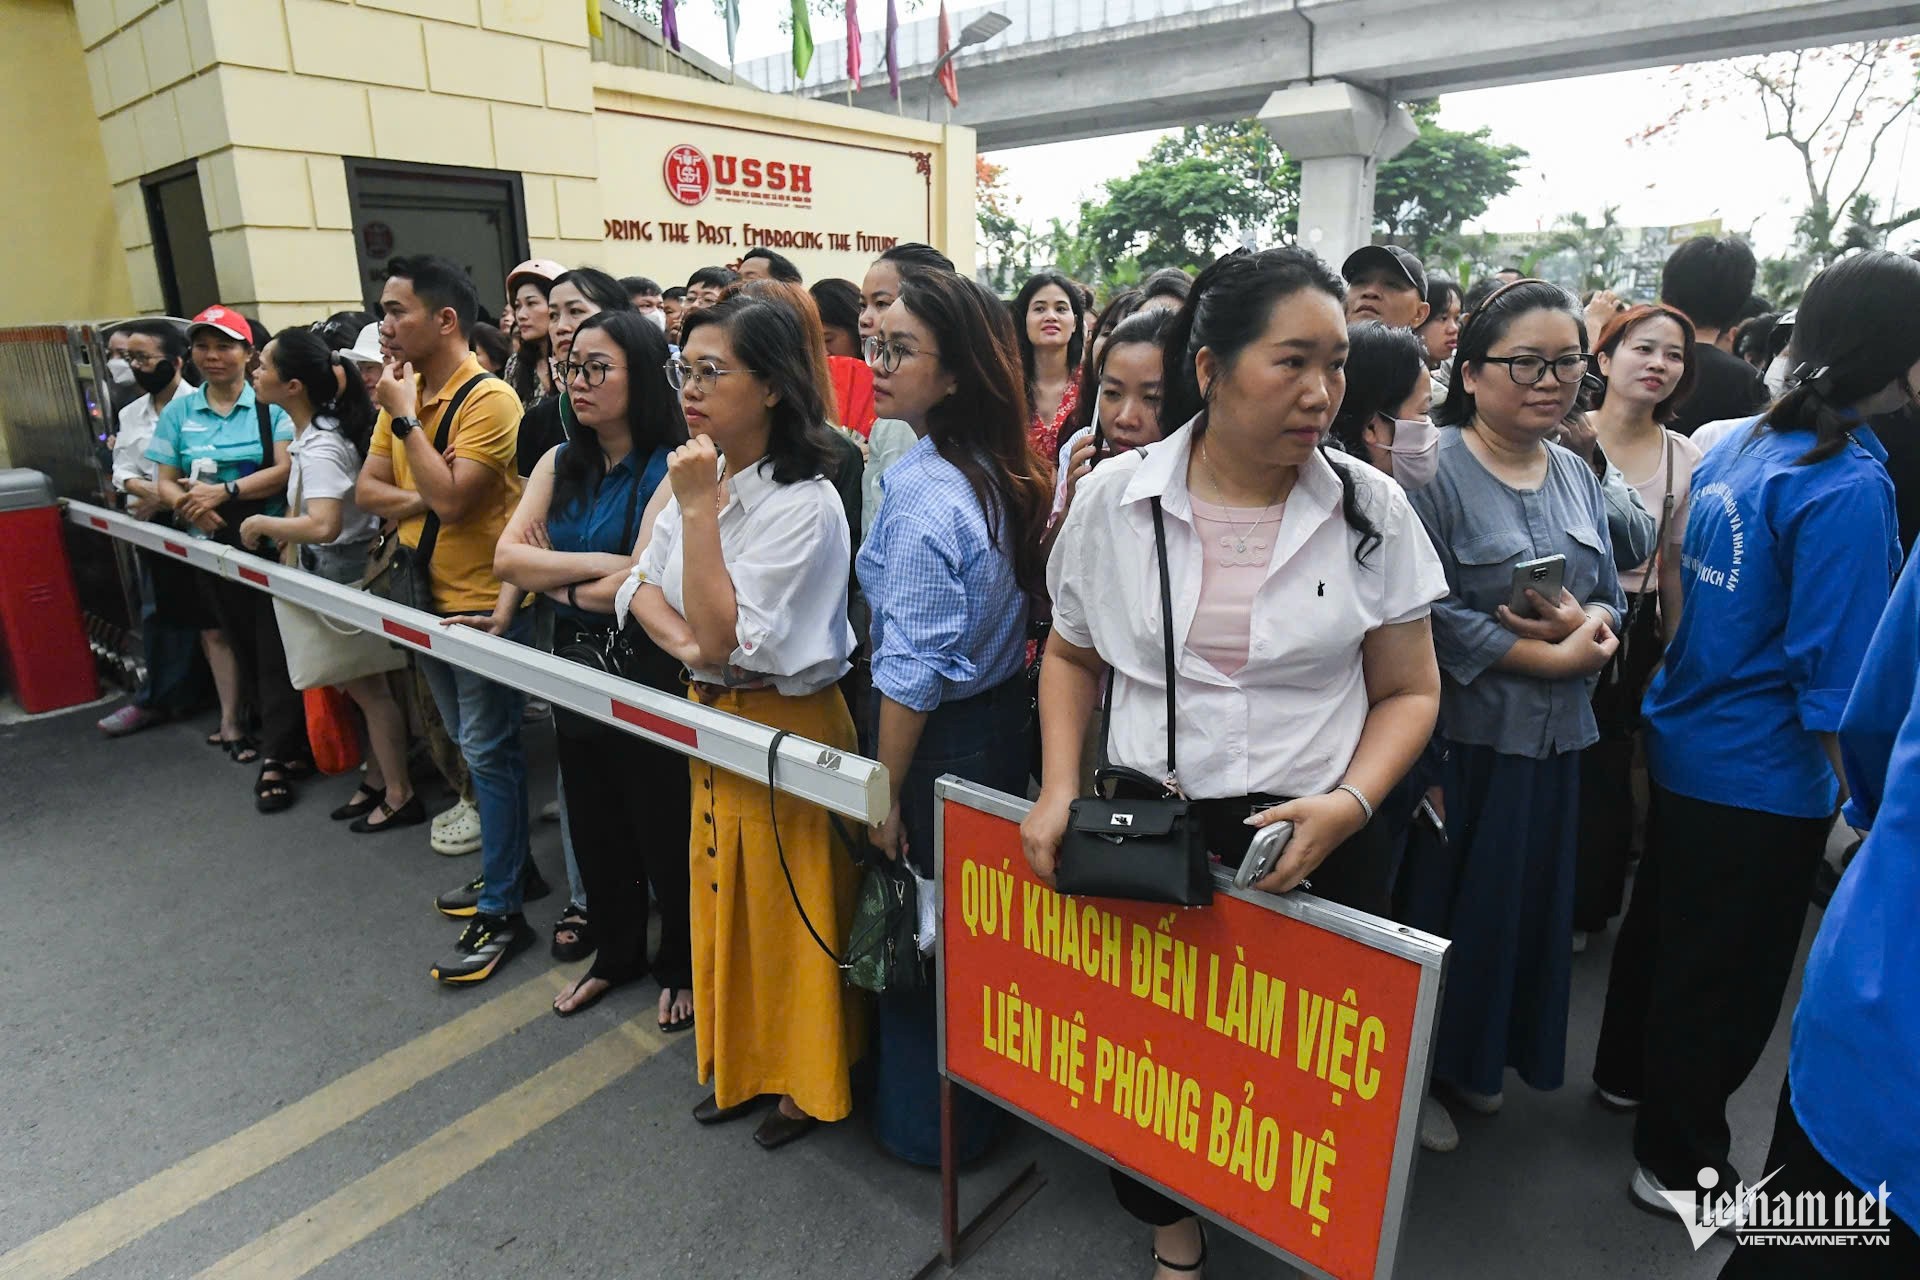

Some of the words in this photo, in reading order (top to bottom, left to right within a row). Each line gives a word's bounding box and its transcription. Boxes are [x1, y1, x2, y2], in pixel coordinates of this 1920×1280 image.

[712, 154, 812, 193] USSH
[658, 222, 690, 243] THE
[743, 223, 823, 250] EMBRACING
[828, 233, 851, 251] THE
[1730, 513, 1744, 532] VÀ
[1700, 565, 1725, 587] KÍCH
[962, 858, 1013, 942] QUÝ
[1130, 912, 1198, 1021] ĐẾN
[1206, 946, 1287, 1059] LÀM
[1296, 988, 1386, 1107] VIỆC
[983, 982, 1043, 1073] LIÊN
[1049, 1010, 1087, 1109] HỆ
[1093, 1035, 1201, 1154] PHÒNG
[1207, 1080, 1280, 1192] BẢO
[1290, 1128, 1337, 1238] VỆ
